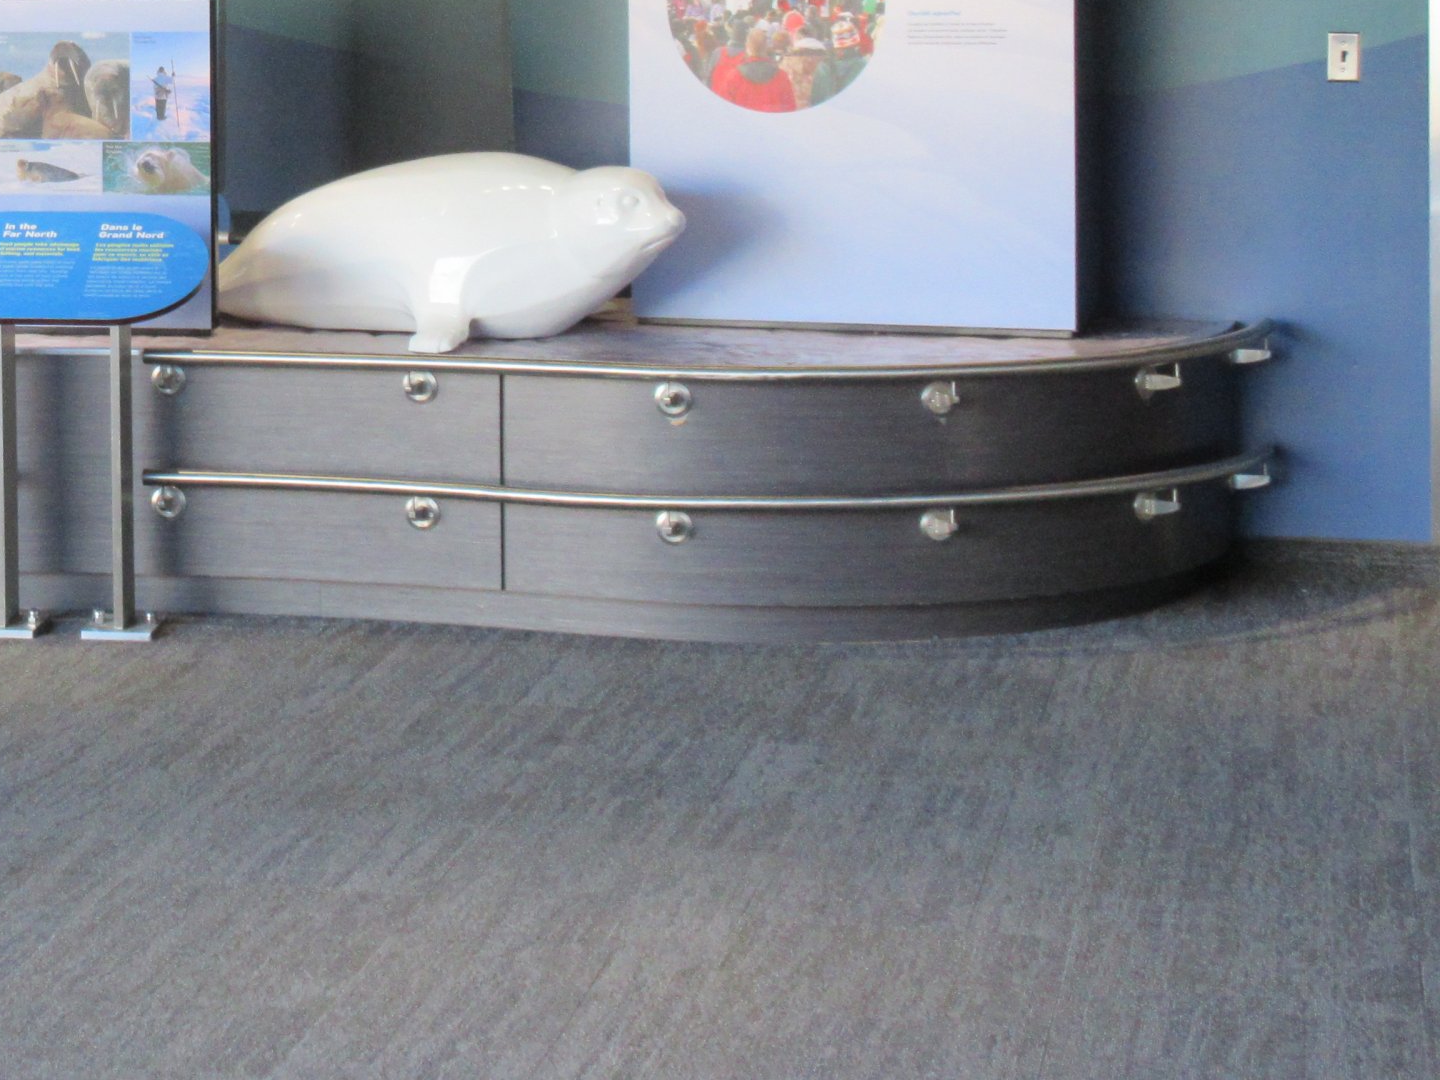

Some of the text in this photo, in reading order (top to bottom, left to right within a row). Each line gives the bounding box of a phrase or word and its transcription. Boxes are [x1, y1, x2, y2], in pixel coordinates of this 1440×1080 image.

[101, 223, 143, 231] Dans le
[99, 231, 133, 239] Grand
